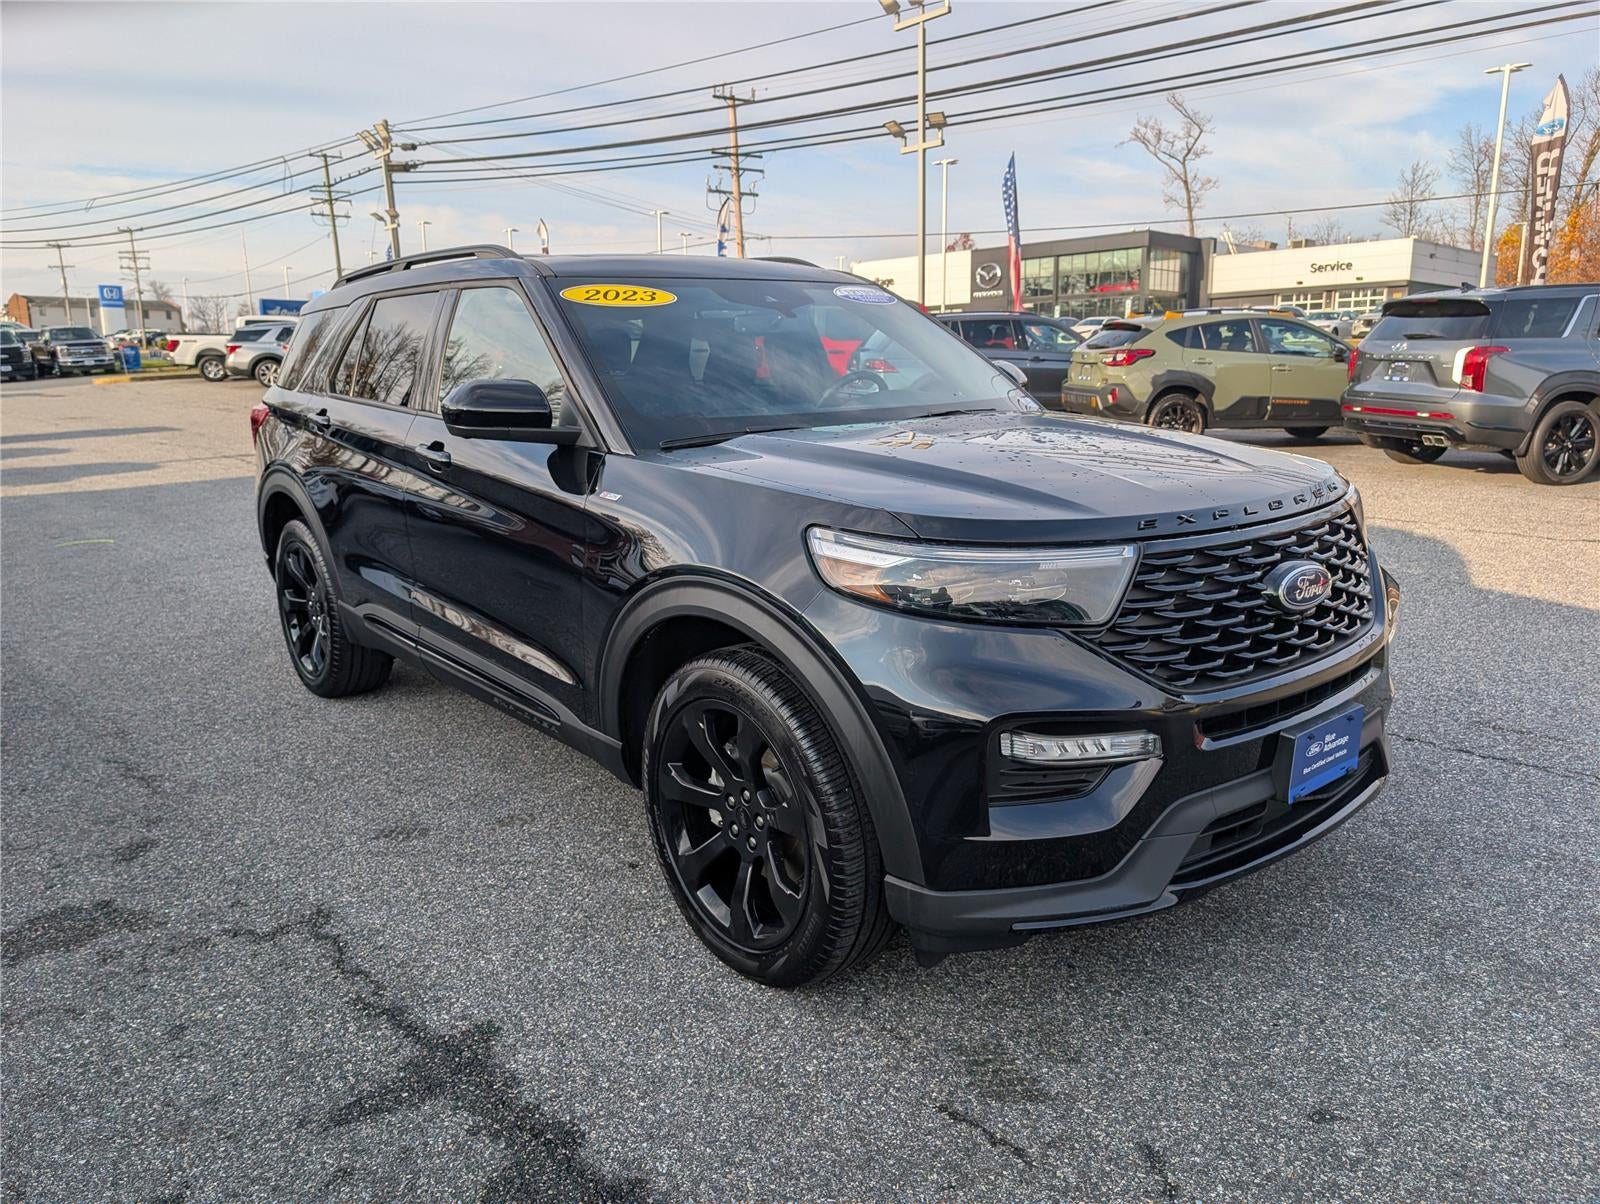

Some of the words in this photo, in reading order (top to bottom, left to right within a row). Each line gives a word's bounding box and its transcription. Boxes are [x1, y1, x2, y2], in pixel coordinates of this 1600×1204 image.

[1310, 260, 1353, 273] Service
[583, 289, 657, 302] 2023
[1137, 482, 1338, 531] EXPLORER
[1295, 572, 1324, 601] Ford
[1323, 735, 1349, 752] Advantage
[1324, 732, 1336, 743] Blue
